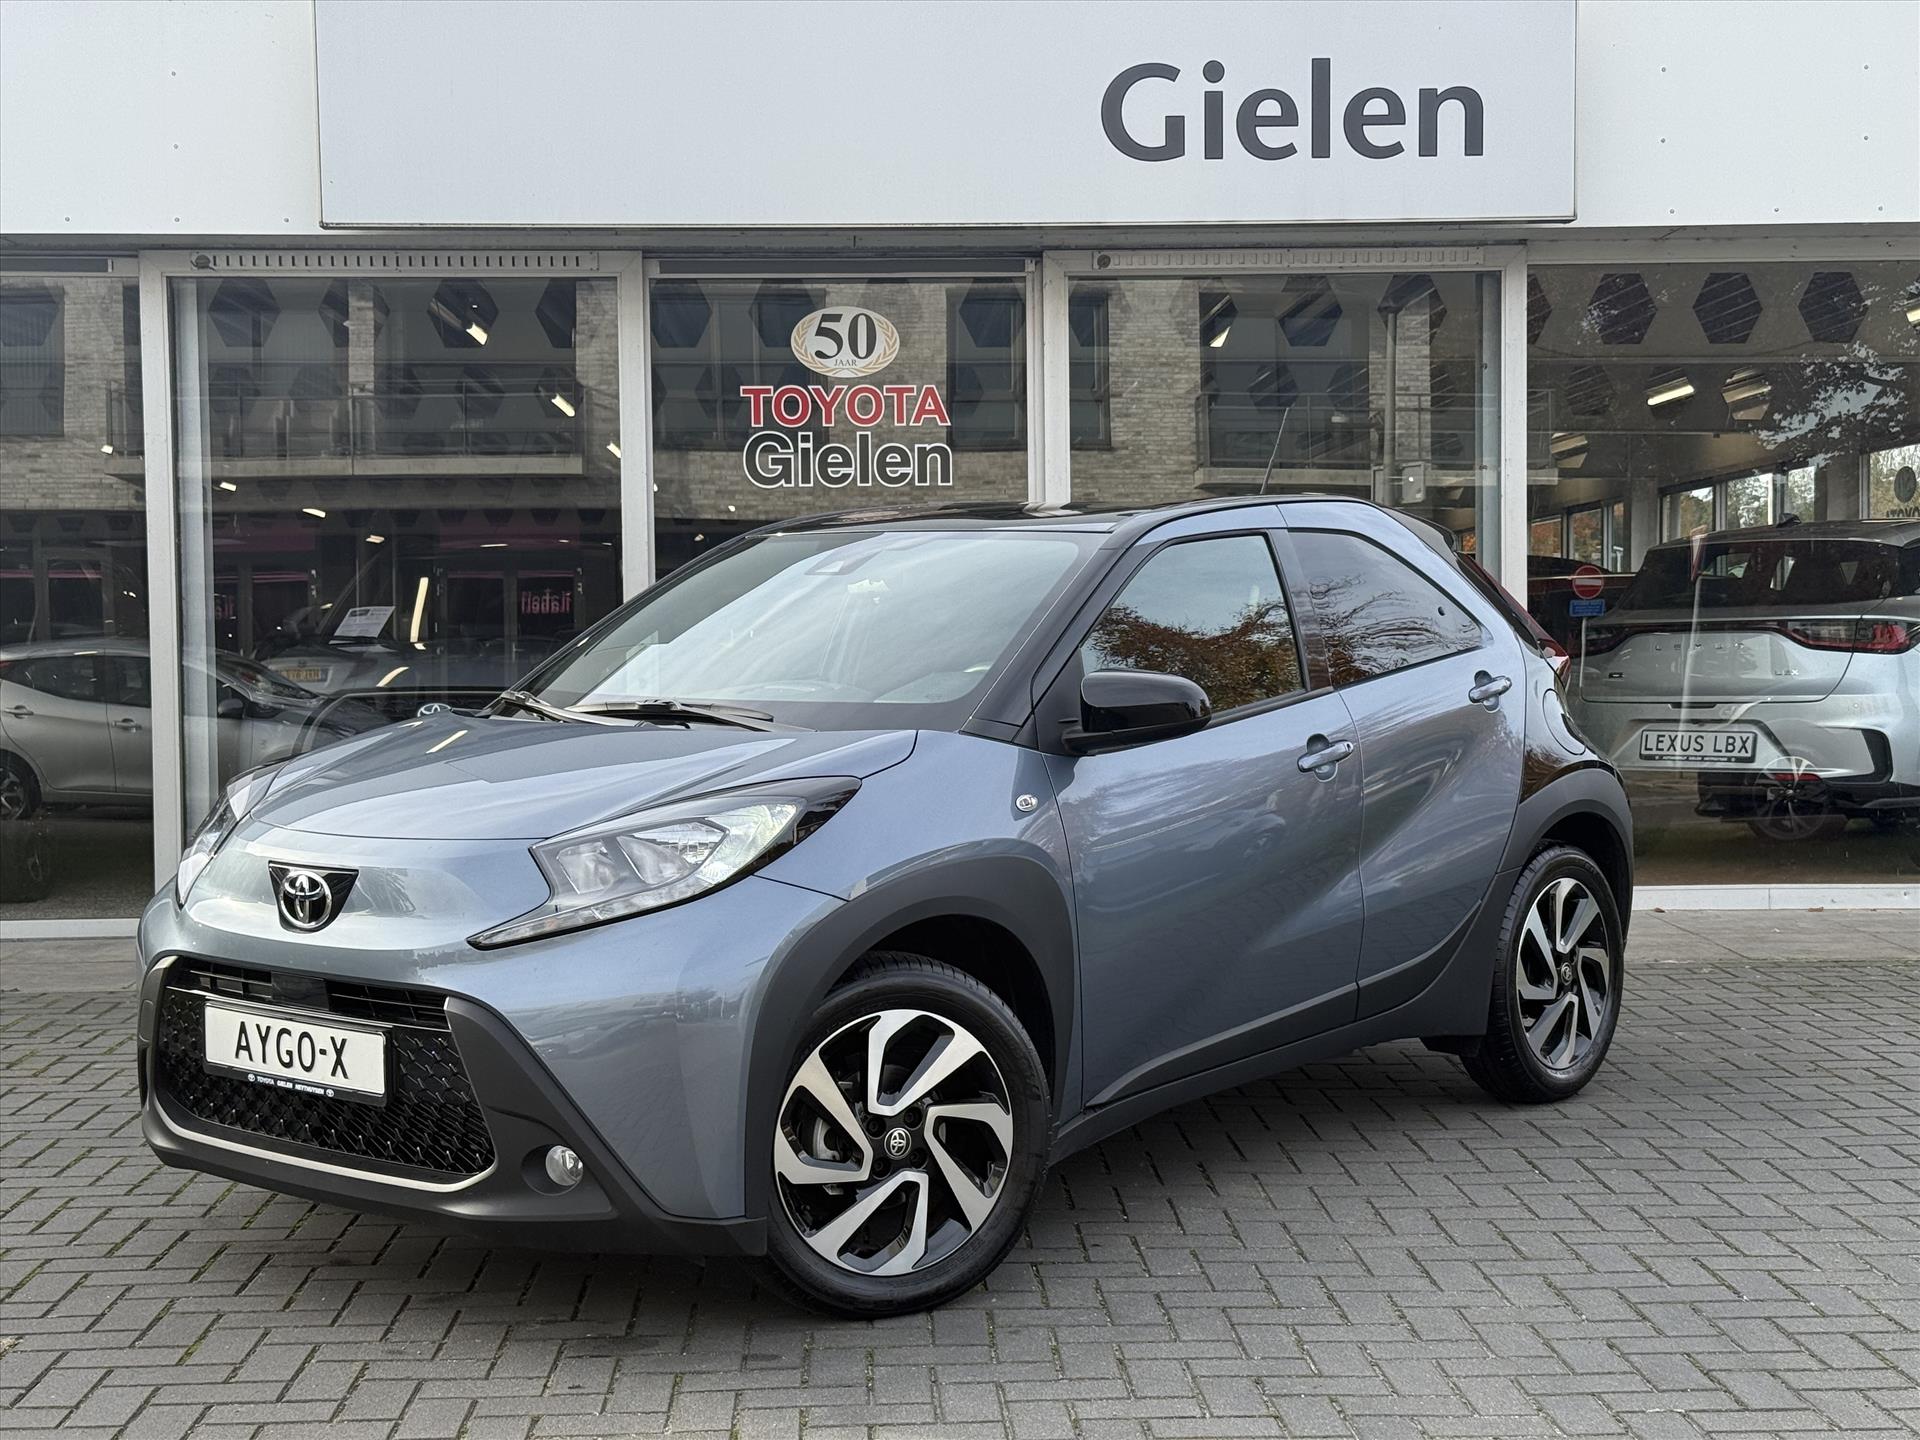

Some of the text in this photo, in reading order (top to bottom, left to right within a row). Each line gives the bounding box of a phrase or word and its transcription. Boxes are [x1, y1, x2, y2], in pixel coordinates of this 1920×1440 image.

[1101, 58, 1484, 162] Gielen
[814, 312, 877, 360] 50
[834, 358, 858, 367] JAAR
[740, 384, 951, 427] TOYOTA
[743, 430, 953, 489] Gielen
[1644, 733, 1750, 754] LEXUS LBX
[234, 1021, 349, 1079] AYGO-X
[256, 1075, 275, 1085] TOYOTA
